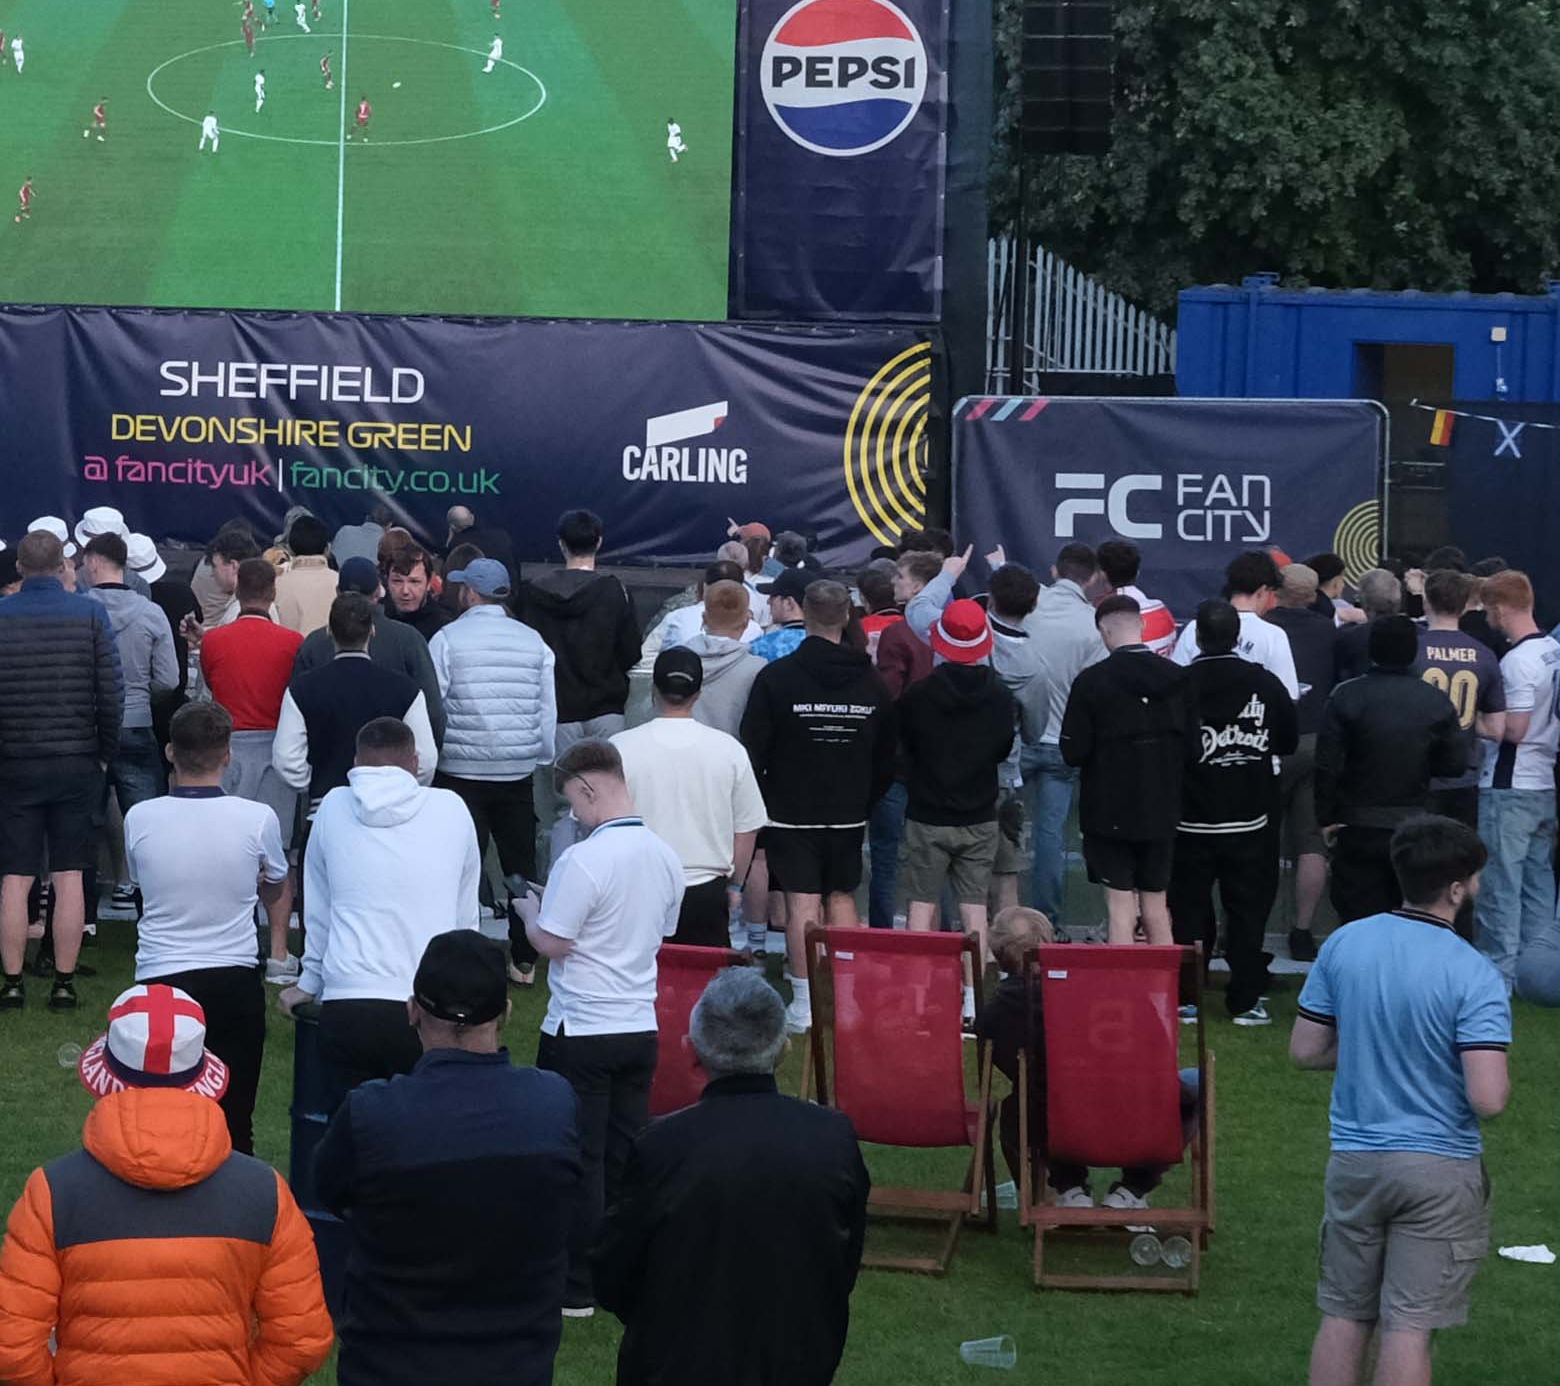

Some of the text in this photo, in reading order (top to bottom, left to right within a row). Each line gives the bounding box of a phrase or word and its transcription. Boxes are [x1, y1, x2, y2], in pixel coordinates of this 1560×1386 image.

[772, 56, 915, 90] PEPSI
[159, 360, 425, 404] SHEFFIELD
[111, 414, 472, 452] DEVONSHIRE GREEN
[289, 461, 502, 495] fancity.co.uk
[622, 445, 748, 485] CARLING
[1054, 473, 1163, 539] FC
[1177, 473, 1272, 507] FAN
[1177, 509, 1272, 542] CITY
[1425, 645, 1477, 662] PALMER
